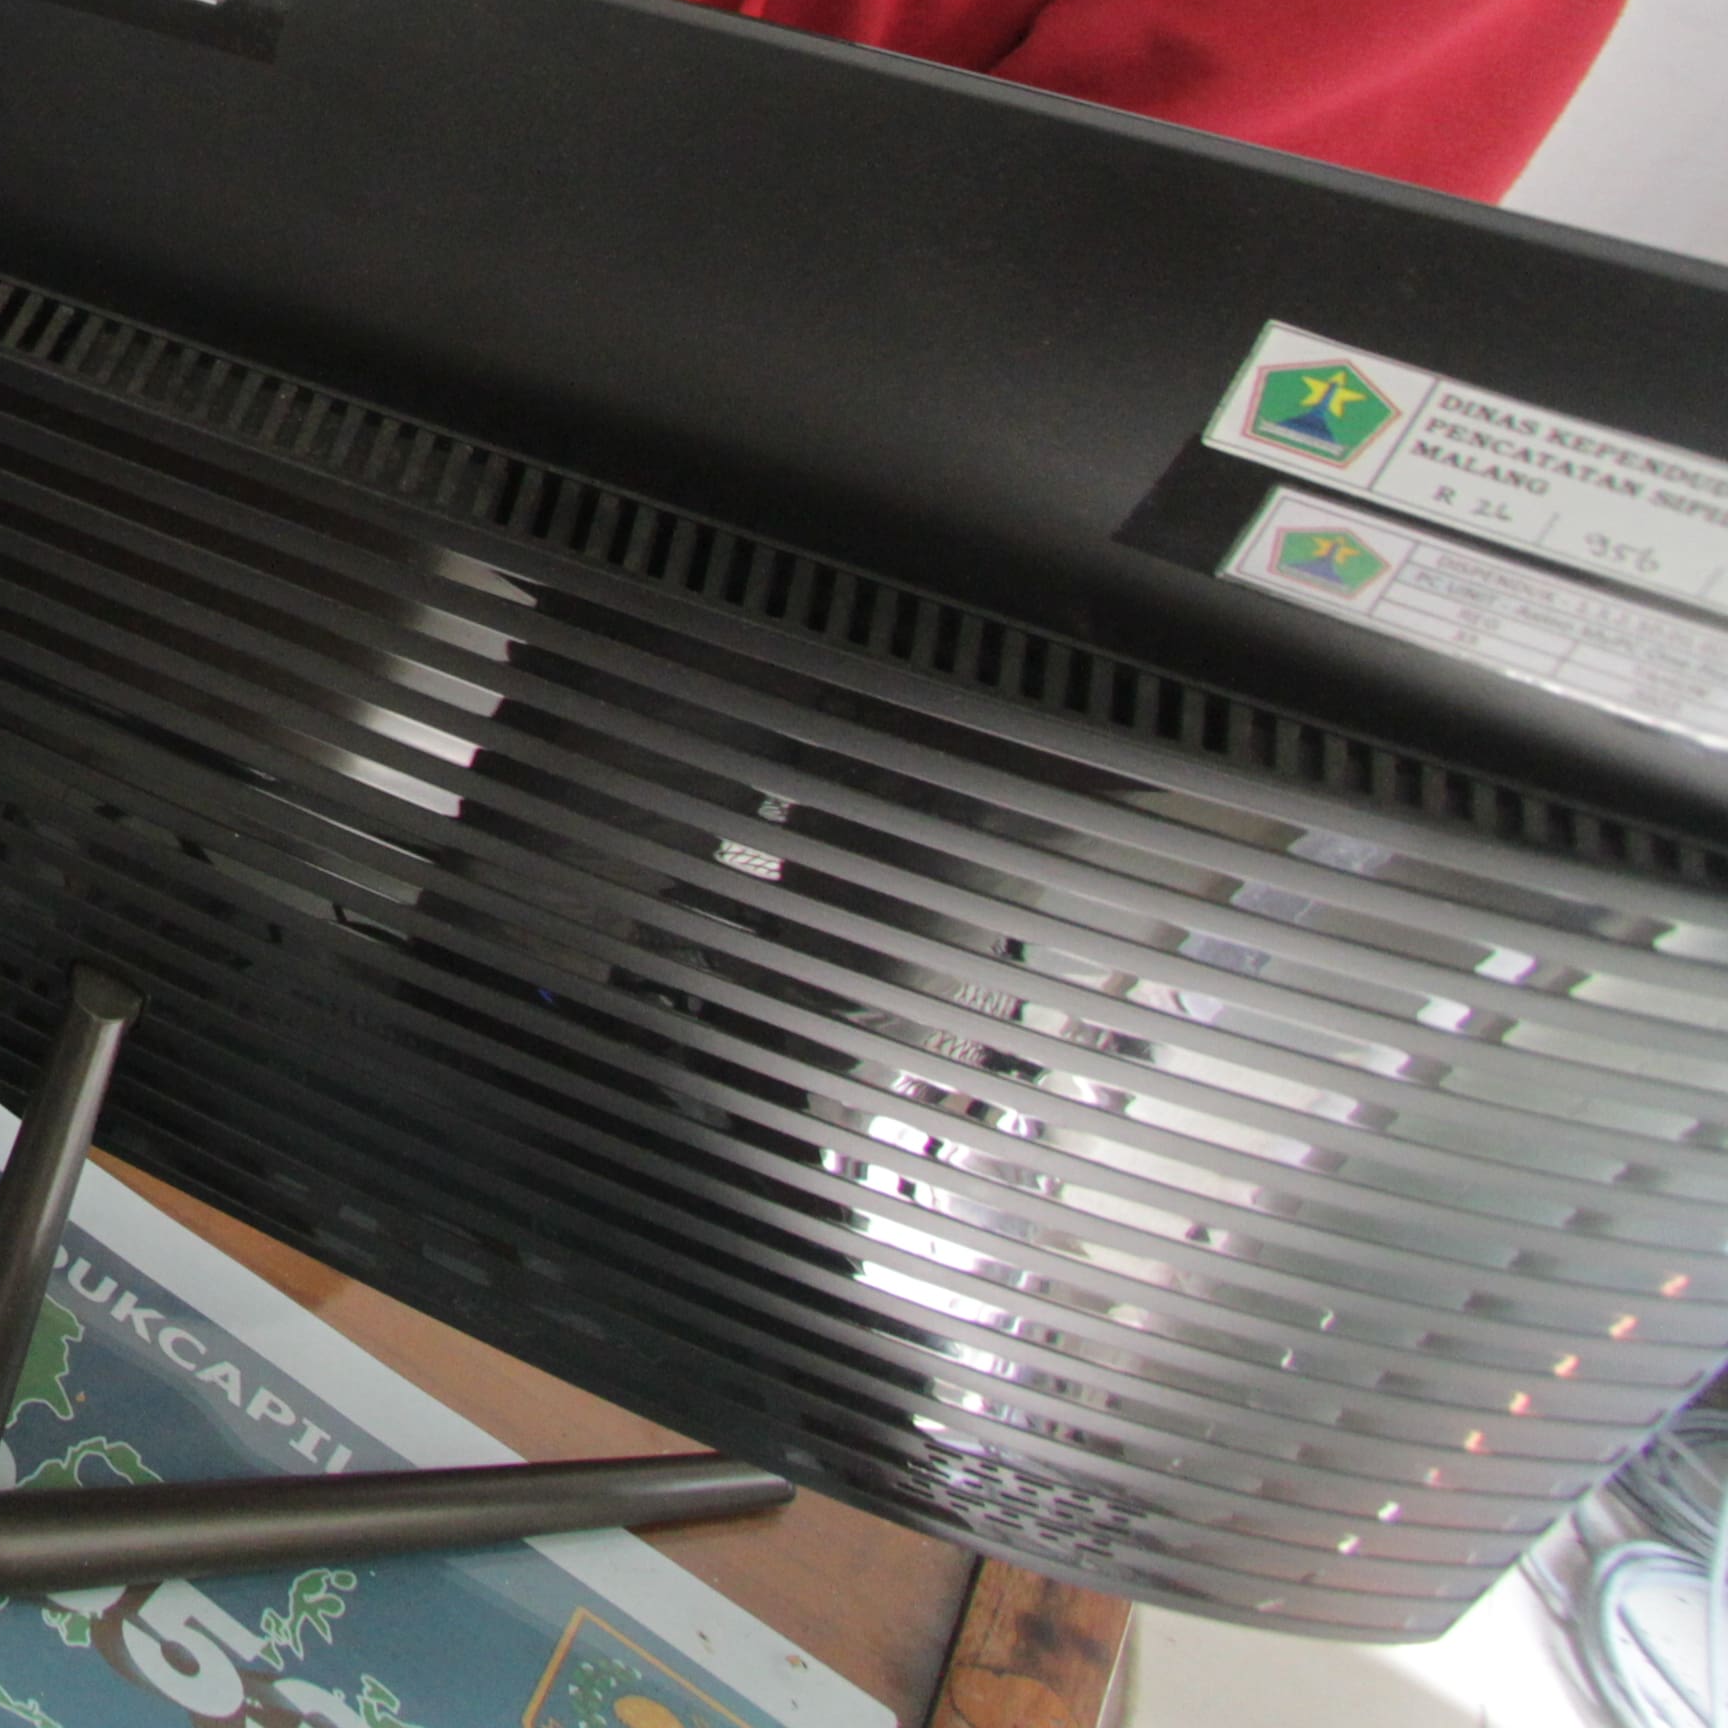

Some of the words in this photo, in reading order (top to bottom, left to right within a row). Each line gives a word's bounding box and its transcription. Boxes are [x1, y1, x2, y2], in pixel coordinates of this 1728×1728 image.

[1439, 392, 1540, 436] DINAS
[1410, 439, 1551, 497] MALANG
[1424, 416, 1644, 499] PENCATATAN
[52, 1243, 354, 1474] UKCAPIL
